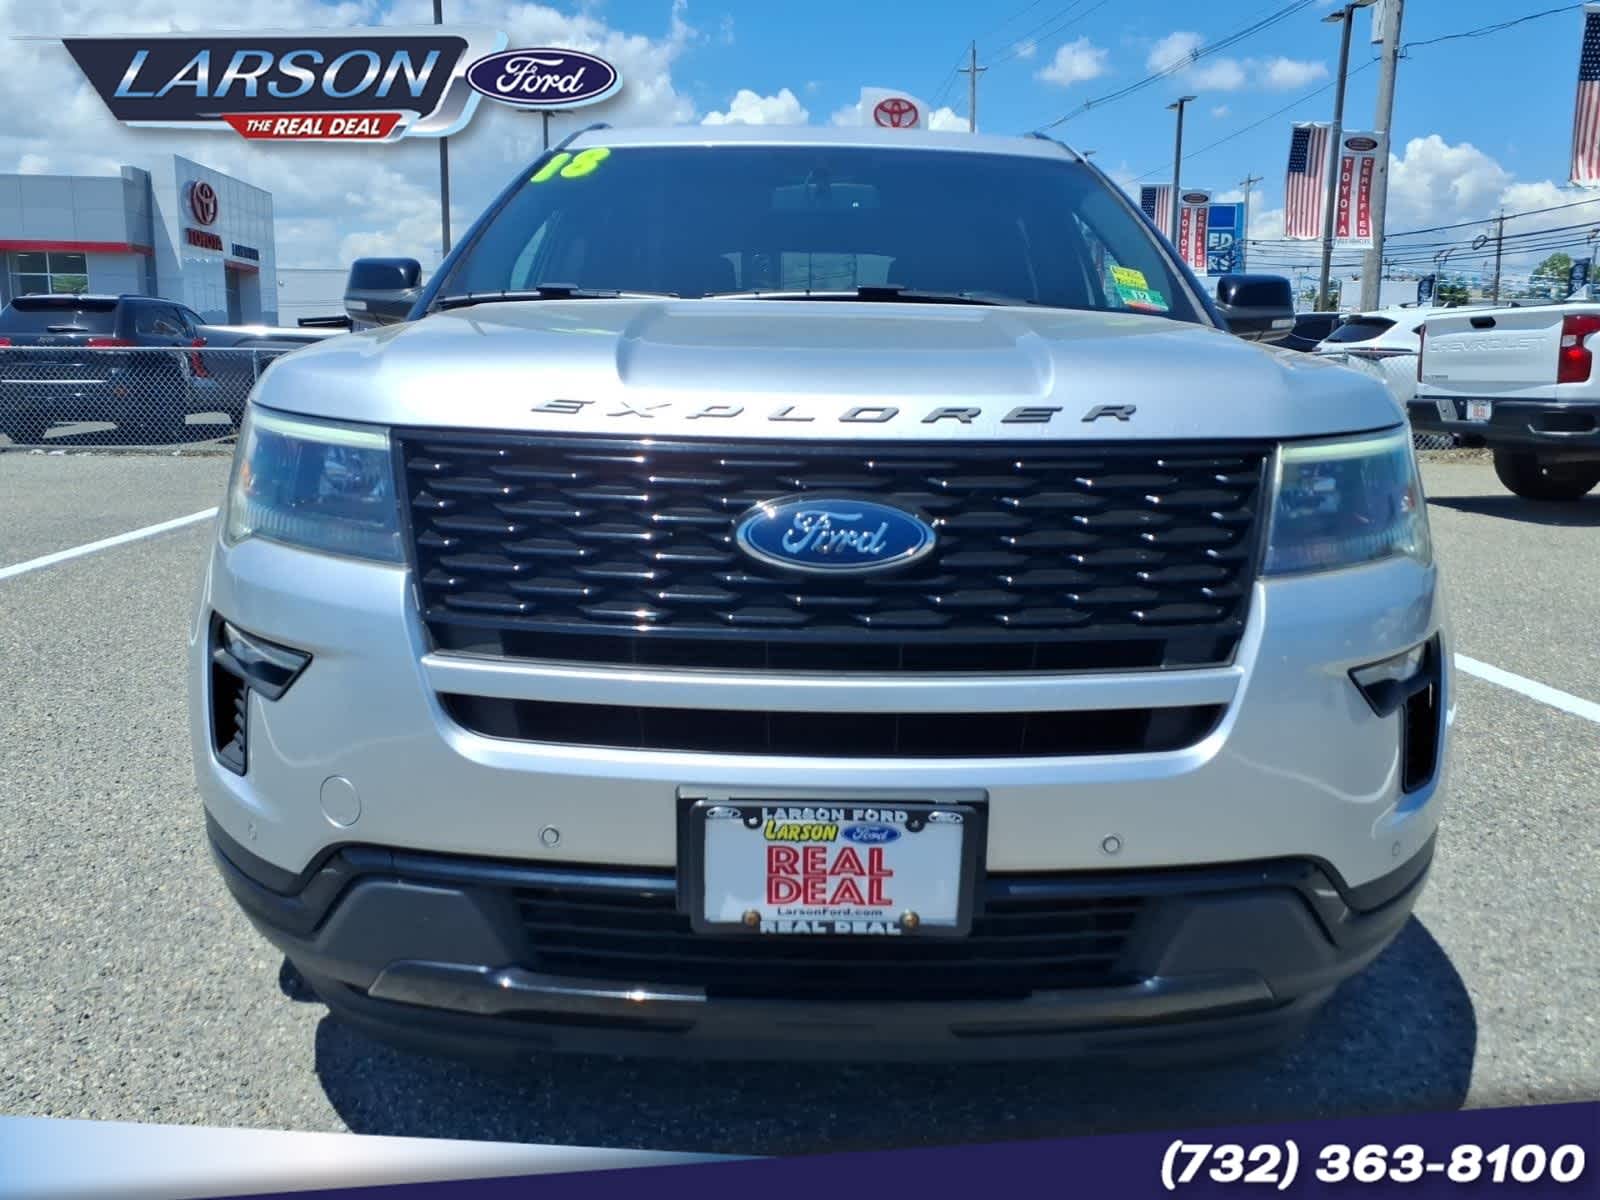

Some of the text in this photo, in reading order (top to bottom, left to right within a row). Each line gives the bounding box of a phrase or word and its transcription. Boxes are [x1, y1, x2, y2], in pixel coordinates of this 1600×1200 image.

[530, 148, 610, 182] 18
[1338, 159, 1352, 235] TOYOTA
[1358, 159, 1372, 236] CERTIFIED
[1428, 335, 1547, 353] CHEVROLET
[530, 399, 1138, 424] EXPLORER
[782, 508, 888, 556] Ford
[761, 807, 846, 823] LARSON
[853, 808, 908, 824] FORD
[762, 820, 889, 843] LARSON Ford
[766, 845, 894, 877] REAL
[766, 875, 893, 906] DEAL
[776, 906, 883, 917] LarsonFord.com
[759, 920, 901, 936] REAL DEAL
